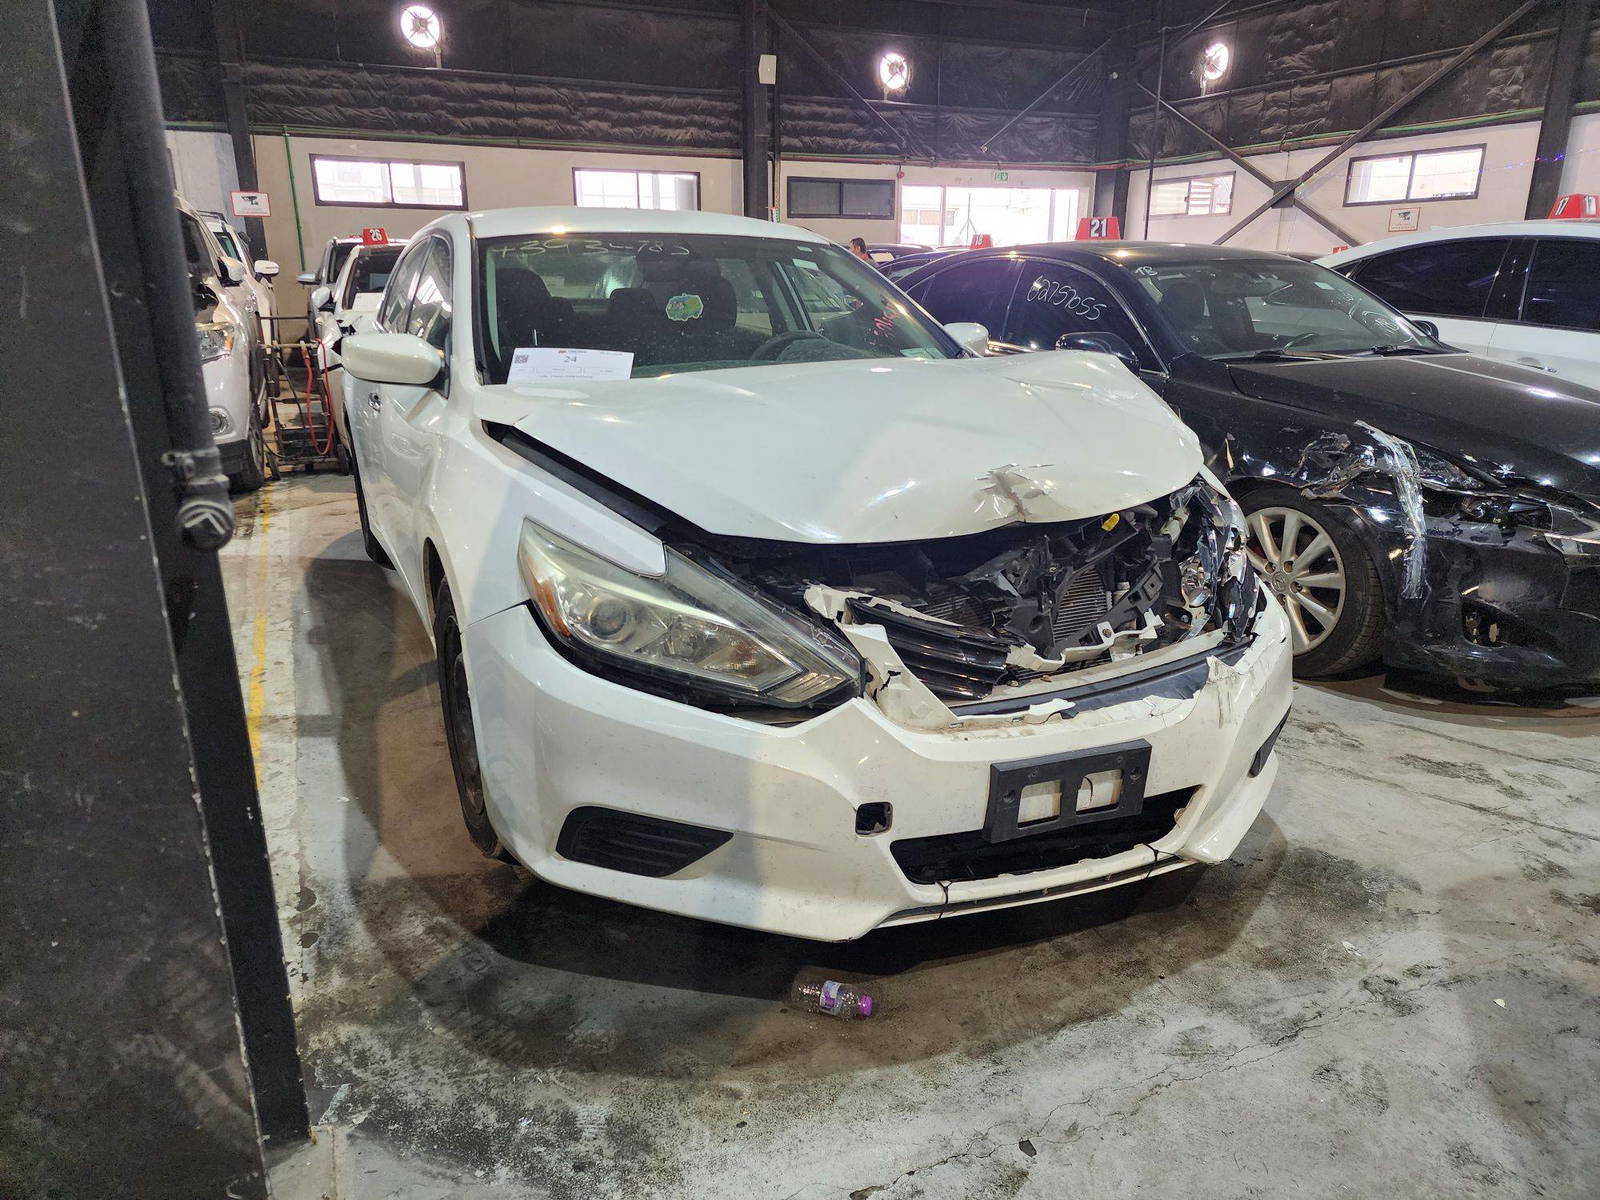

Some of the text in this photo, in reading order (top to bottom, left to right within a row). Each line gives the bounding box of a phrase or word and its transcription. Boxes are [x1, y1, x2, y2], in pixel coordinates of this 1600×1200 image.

[369, 228, 383, 242] 26
[1090, 218, 1107, 238] 21
[563, 355, 578, 363] 24
